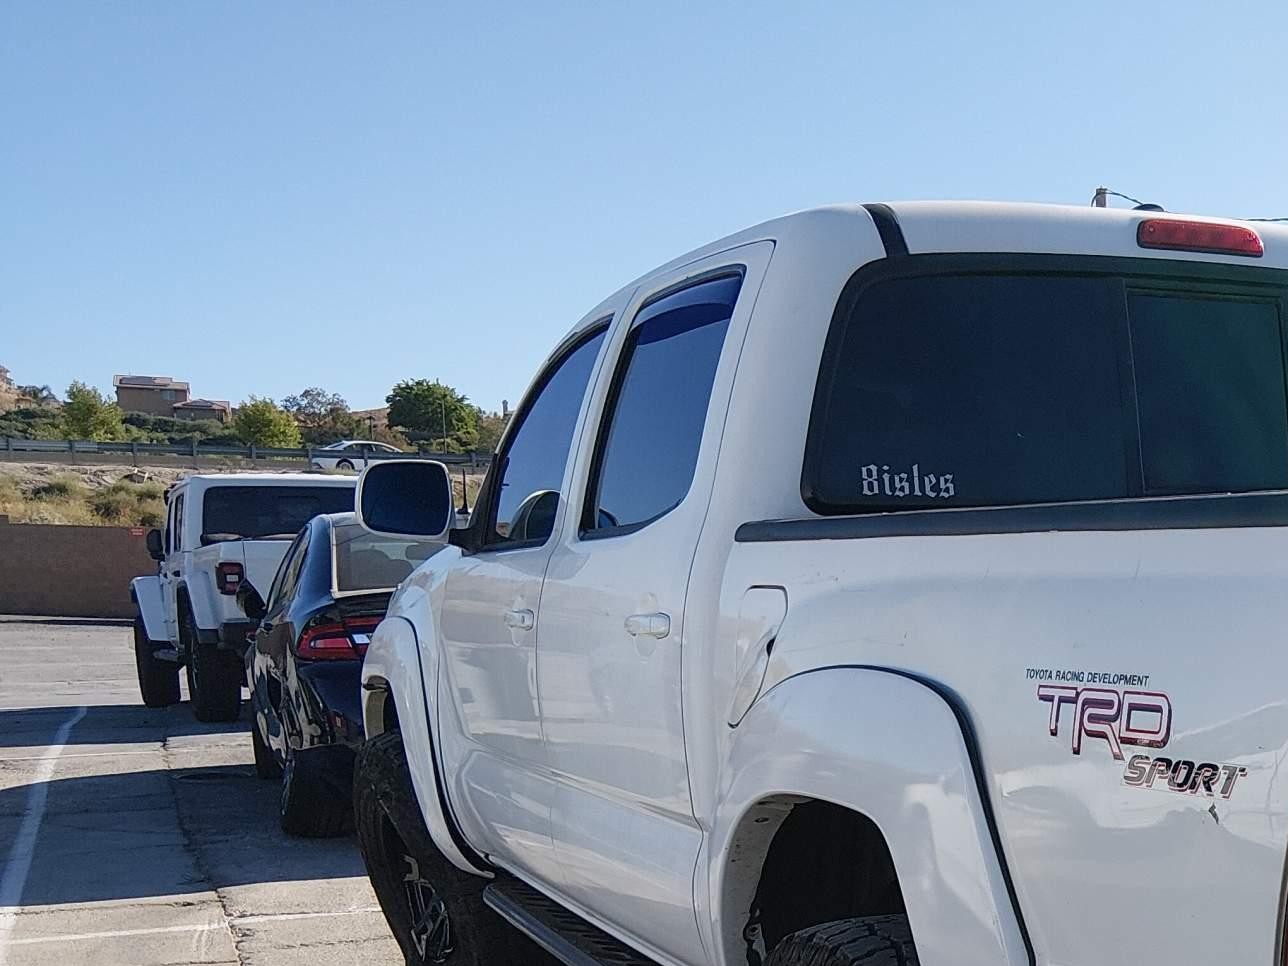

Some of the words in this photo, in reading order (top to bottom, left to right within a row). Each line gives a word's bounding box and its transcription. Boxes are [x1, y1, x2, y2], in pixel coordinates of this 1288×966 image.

[1025, 668, 1053, 680] TOYOTA
[1055, 670, 1085, 682] RACING
[1086, 672, 1150, 686] DEVELOPMENT
[1037, 684, 1173, 761] TRD
[1123, 754, 1248, 799] SPORT
